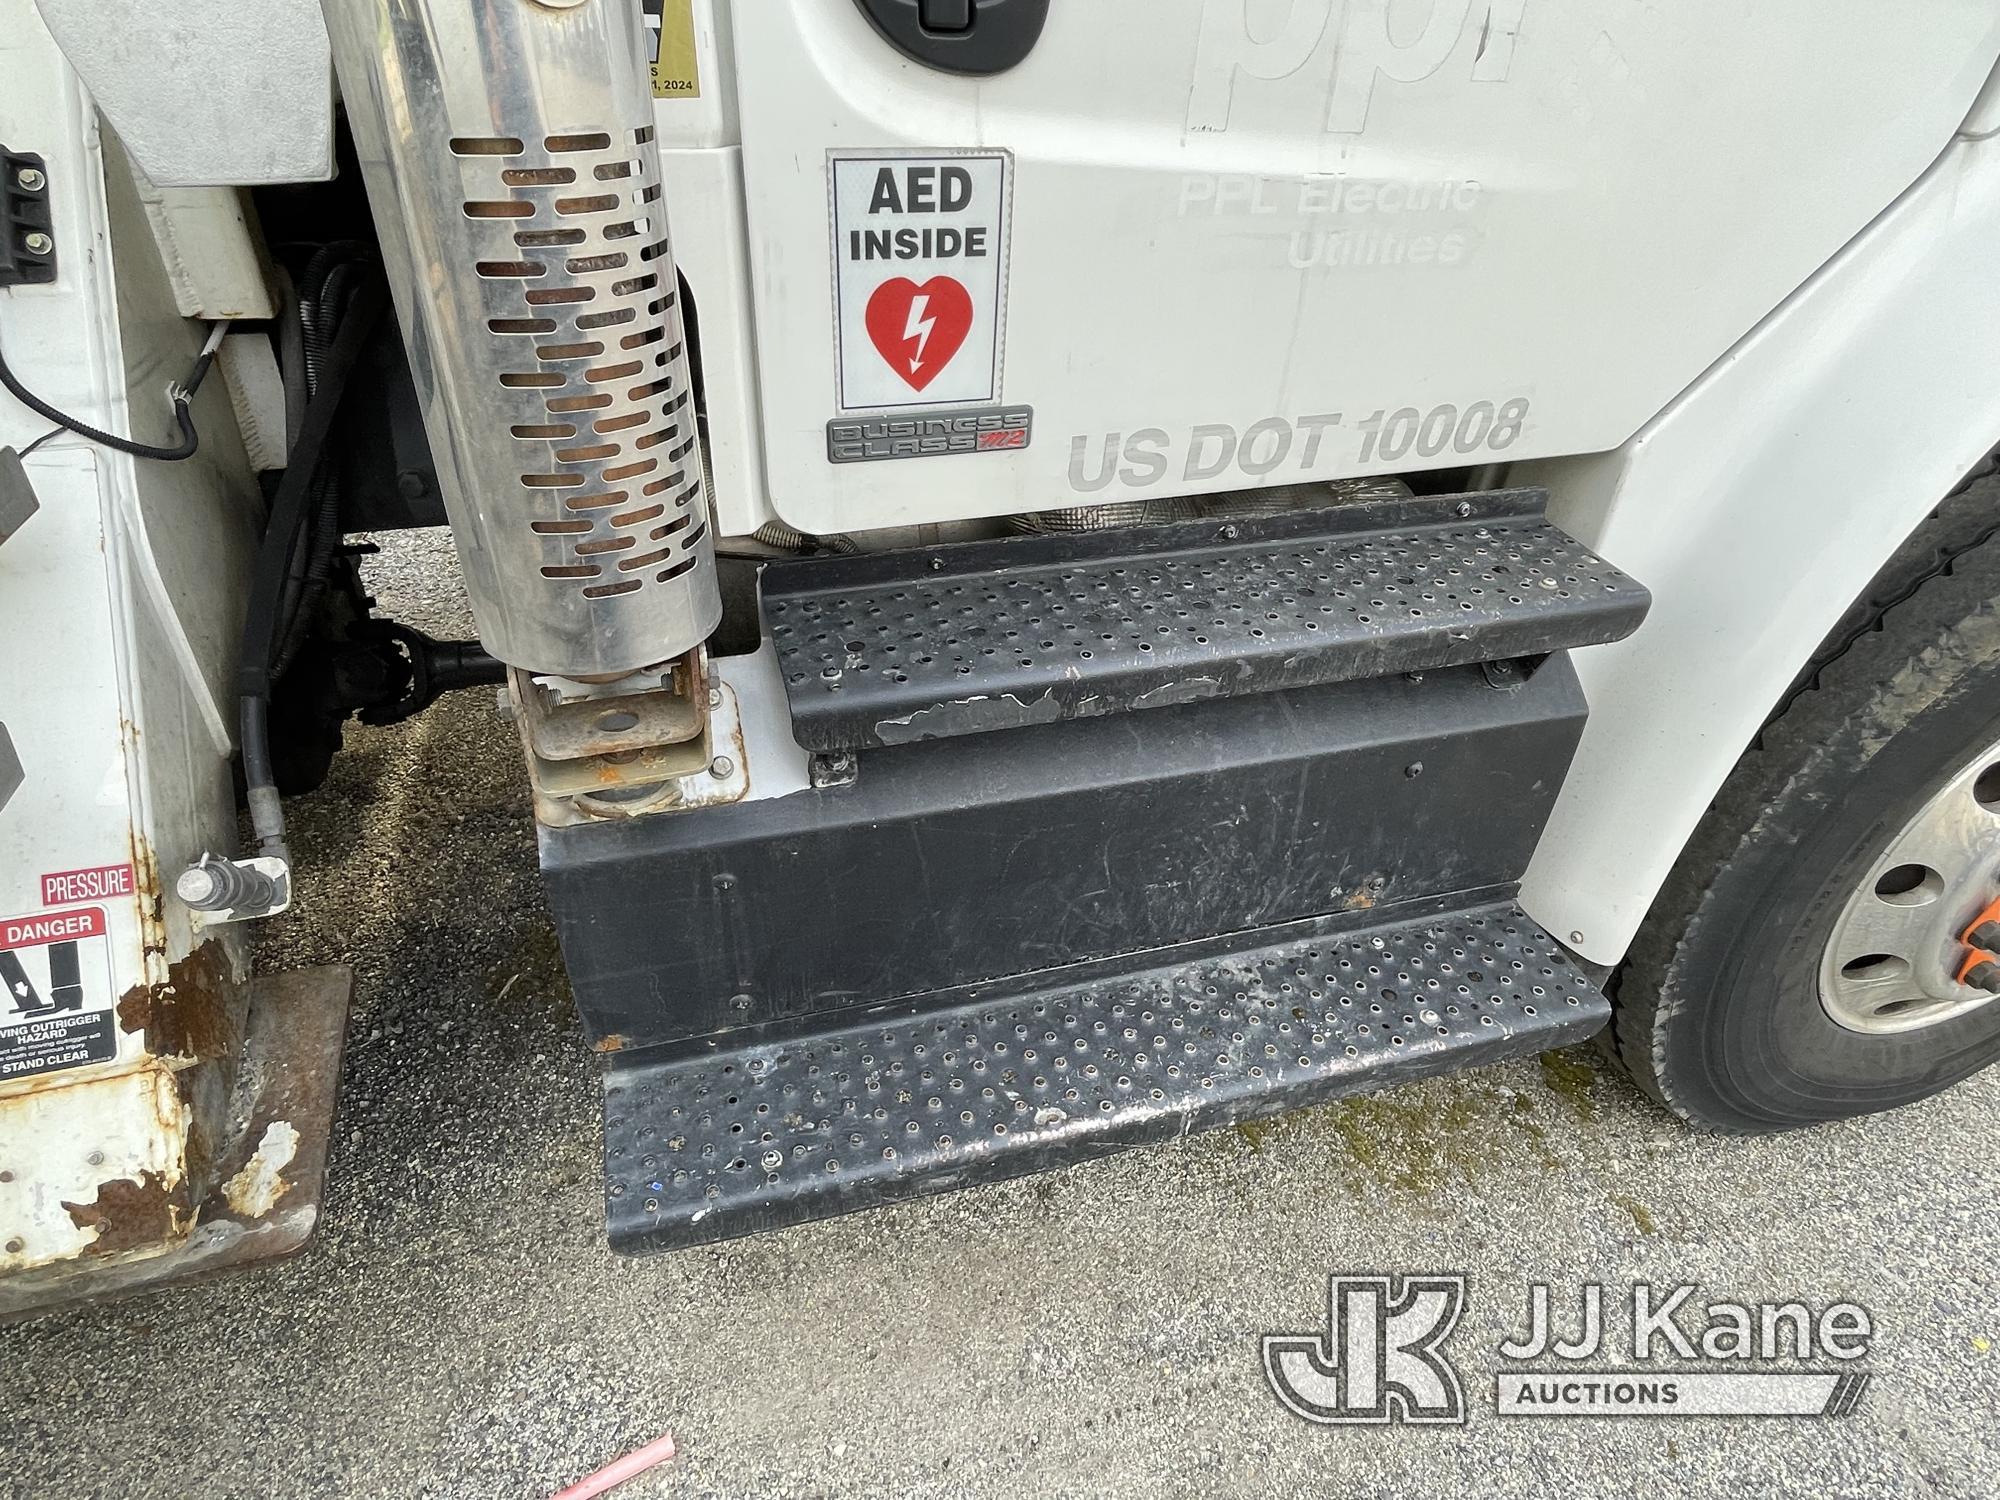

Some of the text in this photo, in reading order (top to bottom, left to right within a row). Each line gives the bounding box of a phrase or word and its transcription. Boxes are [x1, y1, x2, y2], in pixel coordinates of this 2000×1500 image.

[664, 80, 693, 90] 2024
[868, 166, 973, 214] AED
[1176, 175, 1278, 218] PPL
[850, 227, 987, 261] INSIDE
[1287, 229, 1470, 270] Utilities
[832, 412, 1029, 442] BUSINESS
[833, 435, 977, 460] CLASS
[1068, 396, 1530, 493] US DOT 10008
[45, 868, 130, 903] PRESSURE
[7, 915, 93, 943] DANGER
[17, 1028, 67, 1044] HAZARD
[30, 1013, 101, 1033] OUTRIGGER
[5, 1052, 27, 1060] death
[28, 1041, 55, 1050] moving
[2, 1058, 45, 1074] STAND
[46, 1049, 89, 1065] CLEAR
